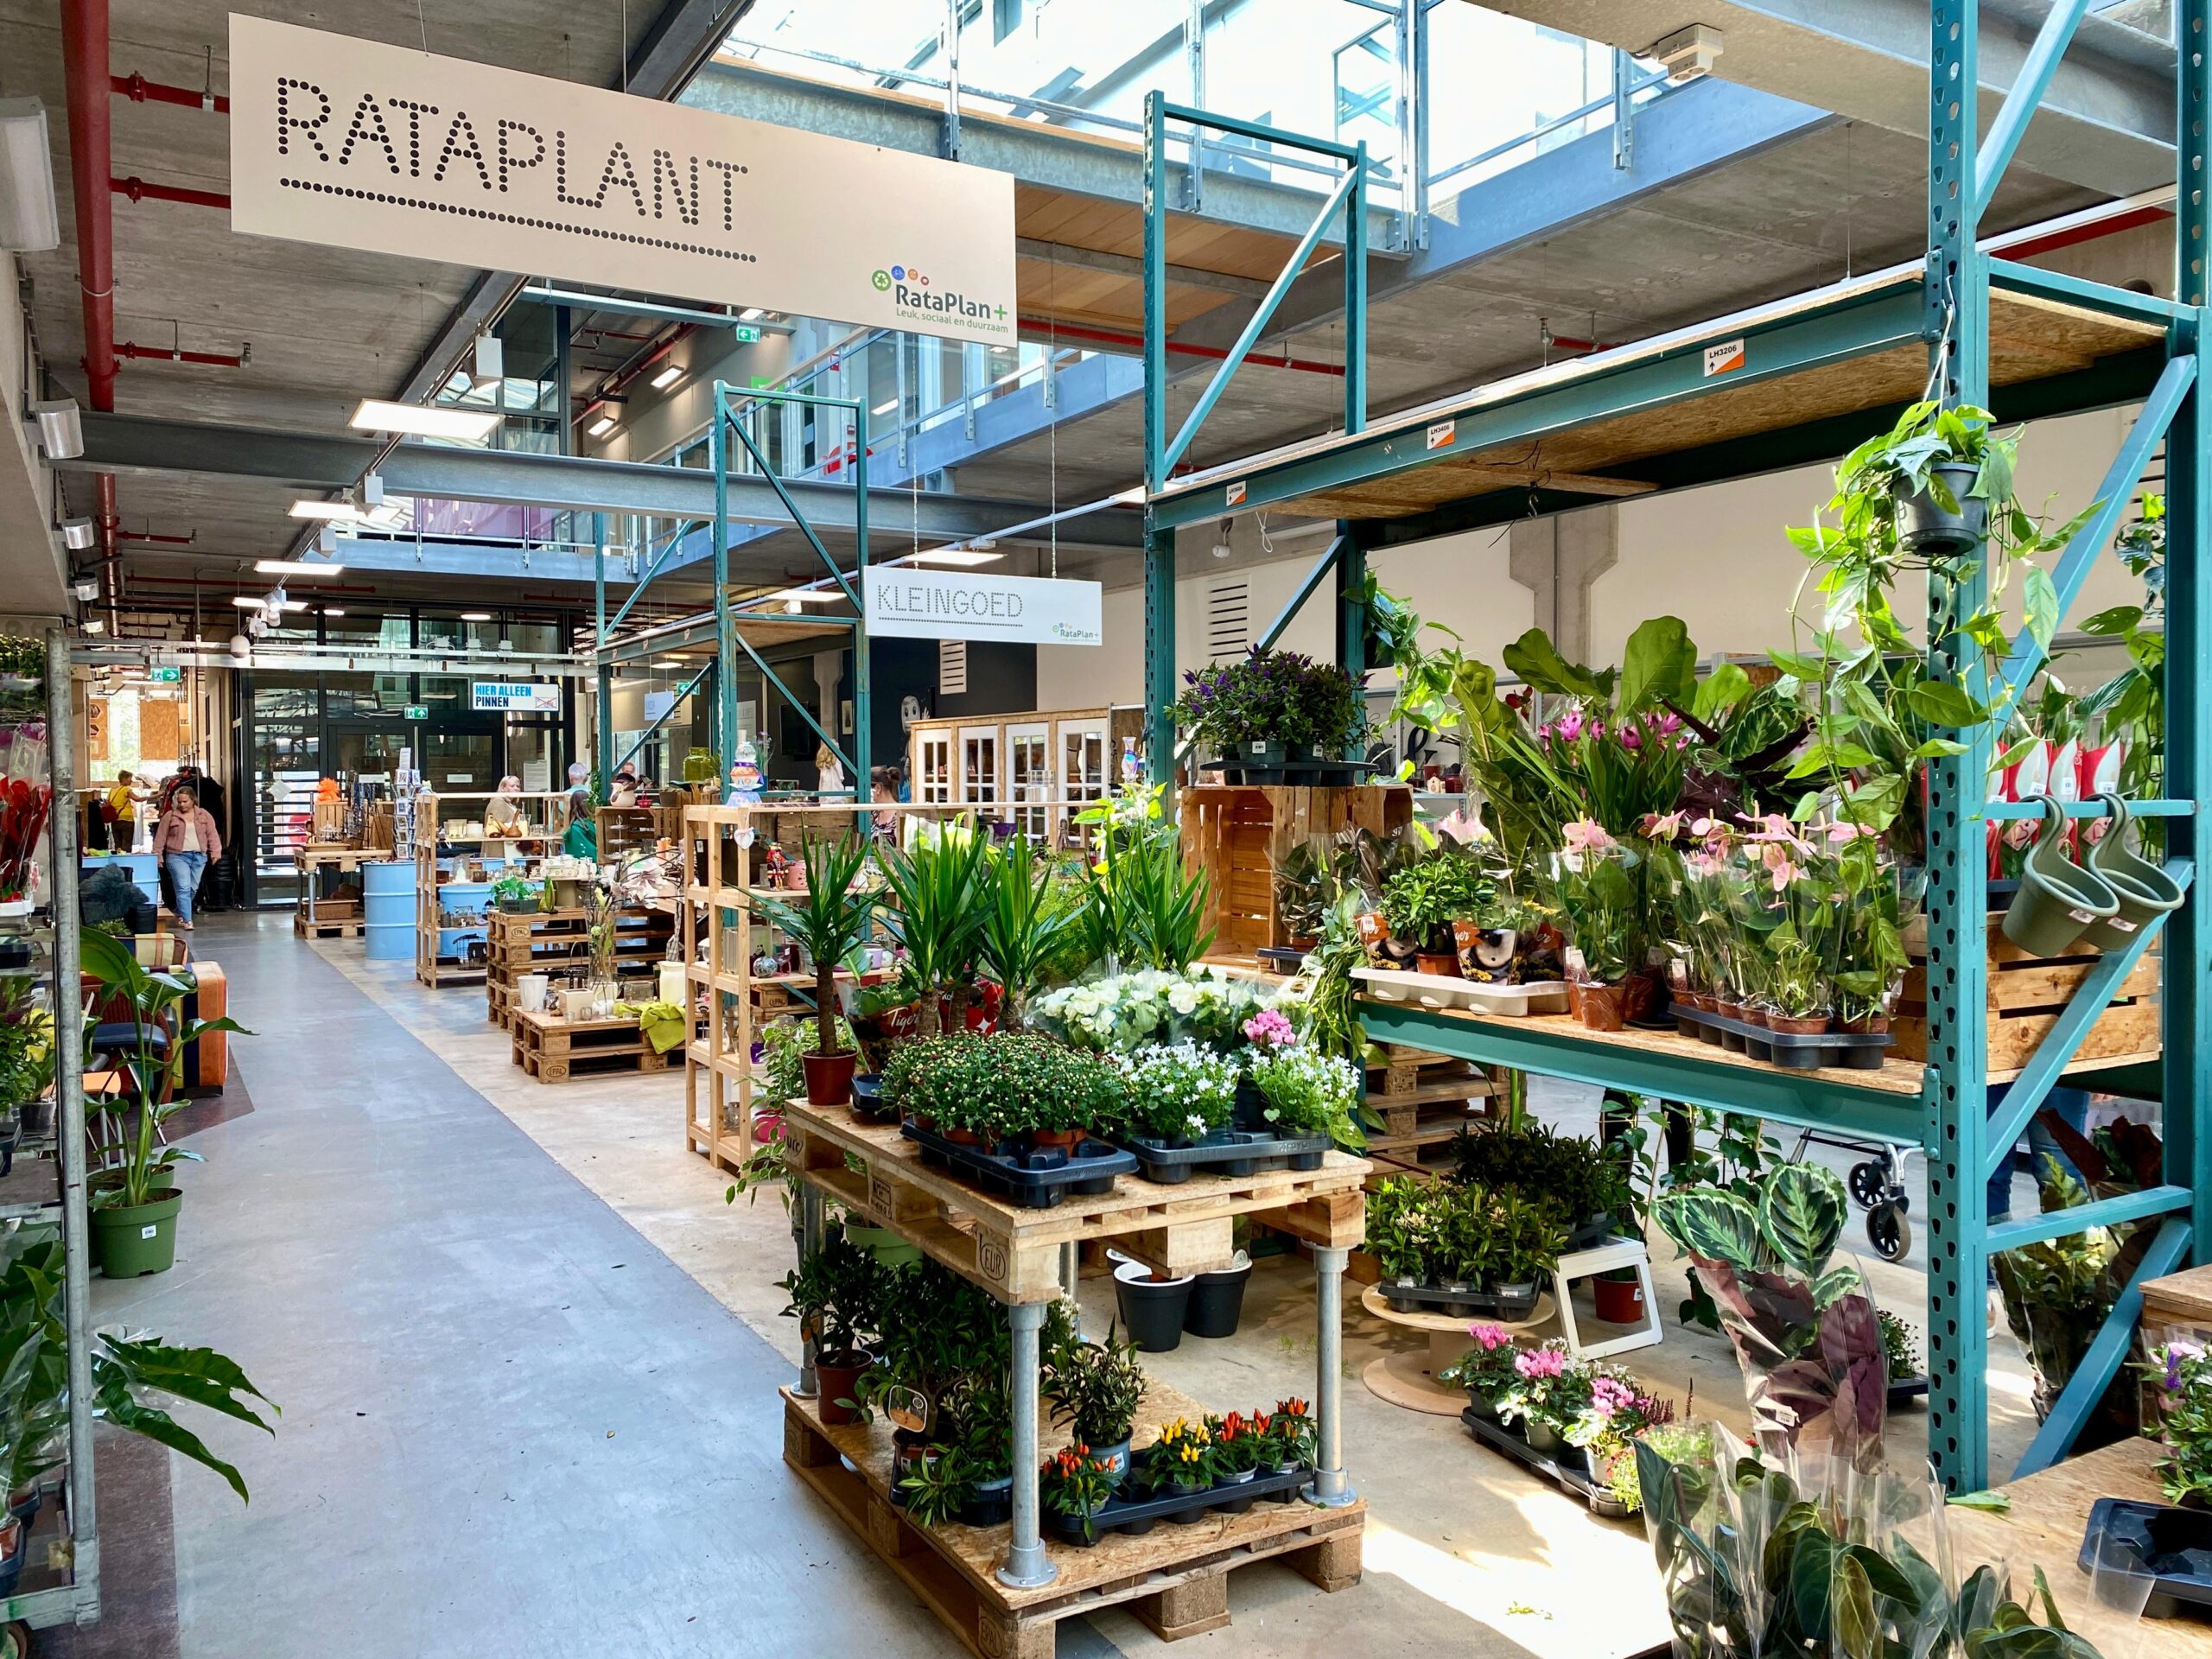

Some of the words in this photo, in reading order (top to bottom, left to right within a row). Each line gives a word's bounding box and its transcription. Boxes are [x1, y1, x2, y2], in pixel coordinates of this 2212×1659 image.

[276, 76, 748, 232] RATAPLANT
[896, 308, 919, 321] Leuk,
[921, 312, 952, 325] sociaal
[954, 318, 965, 327] en
[967, 319, 1008, 334] duurzaam
[1709, 345, 1738, 359] LH3206
[877, 584, 1024, 619] KLEINGOED
[475, 684, 497, 696] HIER
[499, 685, 532, 697] ALLEEN
[475, 696, 510, 708] PINNEN
[985, 1248, 1001, 1276] EUR
